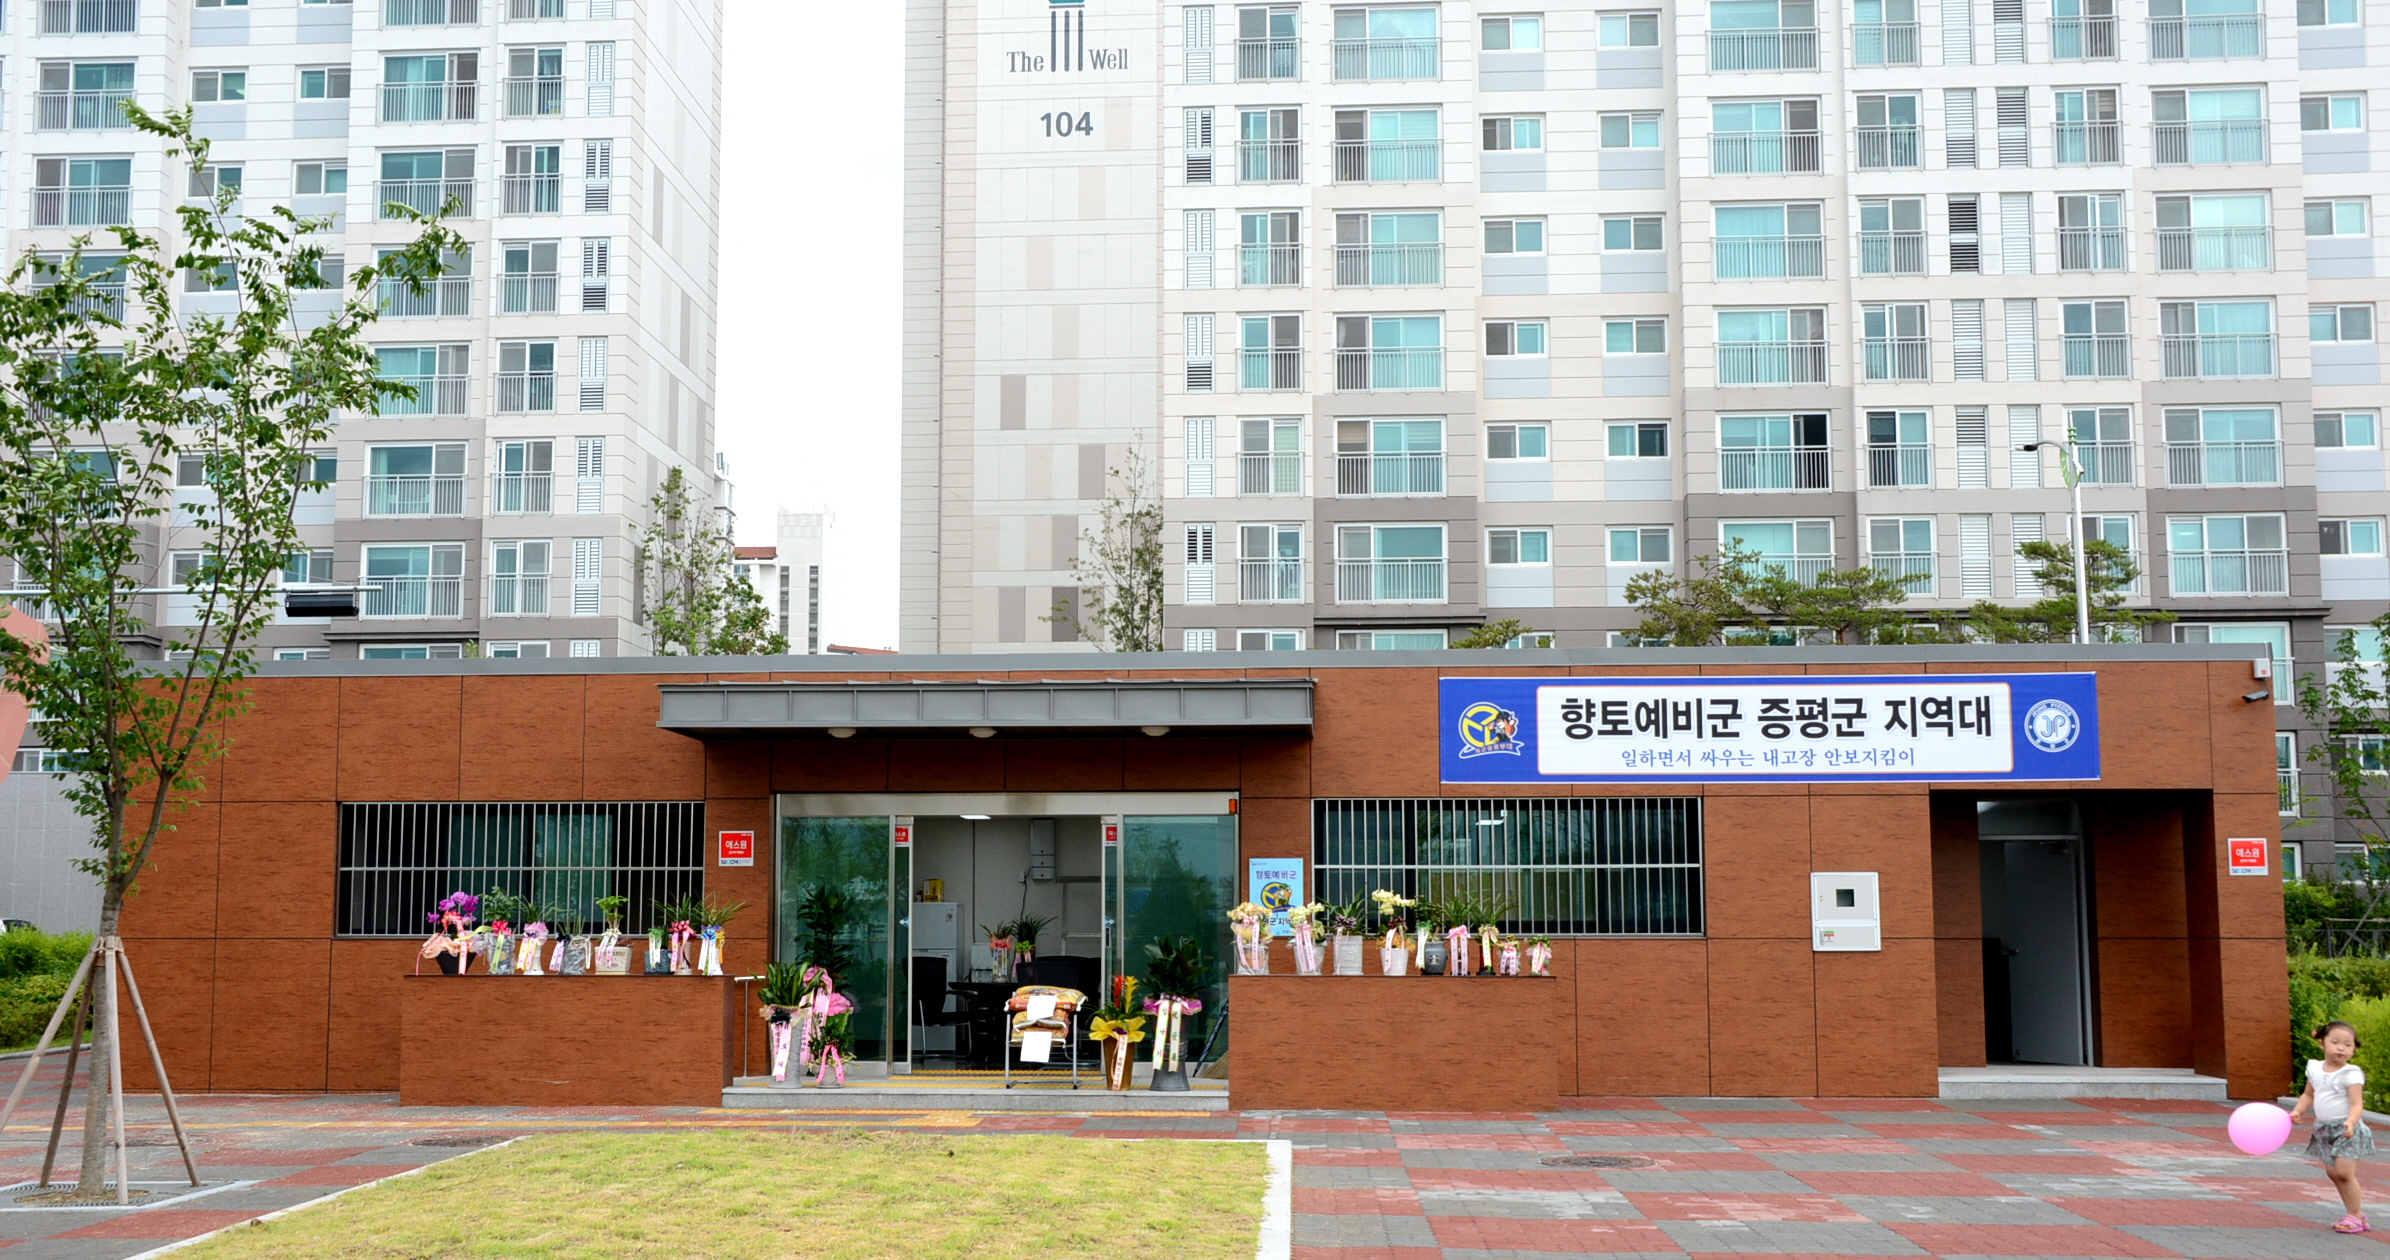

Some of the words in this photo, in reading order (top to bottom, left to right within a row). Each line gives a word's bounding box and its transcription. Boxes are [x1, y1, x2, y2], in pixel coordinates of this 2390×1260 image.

[1006, 51, 1044, 72] The
[1088, 48, 1129, 70] Well
[1040, 111, 1094, 138] 104
[1560, 697, 1743, 740] 향토예비군
[1757, 696, 1868, 739] 증평군
[1884, 695, 1992, 738] 지역대
[1621, 749, 1692, 767] 일하면서
[1699, 749, 1755, 767] 싸우는
[1763, 748, 1817, 767] 내고장
[1824, 747, 1915, 767] 안보지킴이
[1255, 870, 1298, 880] 향토예비군
